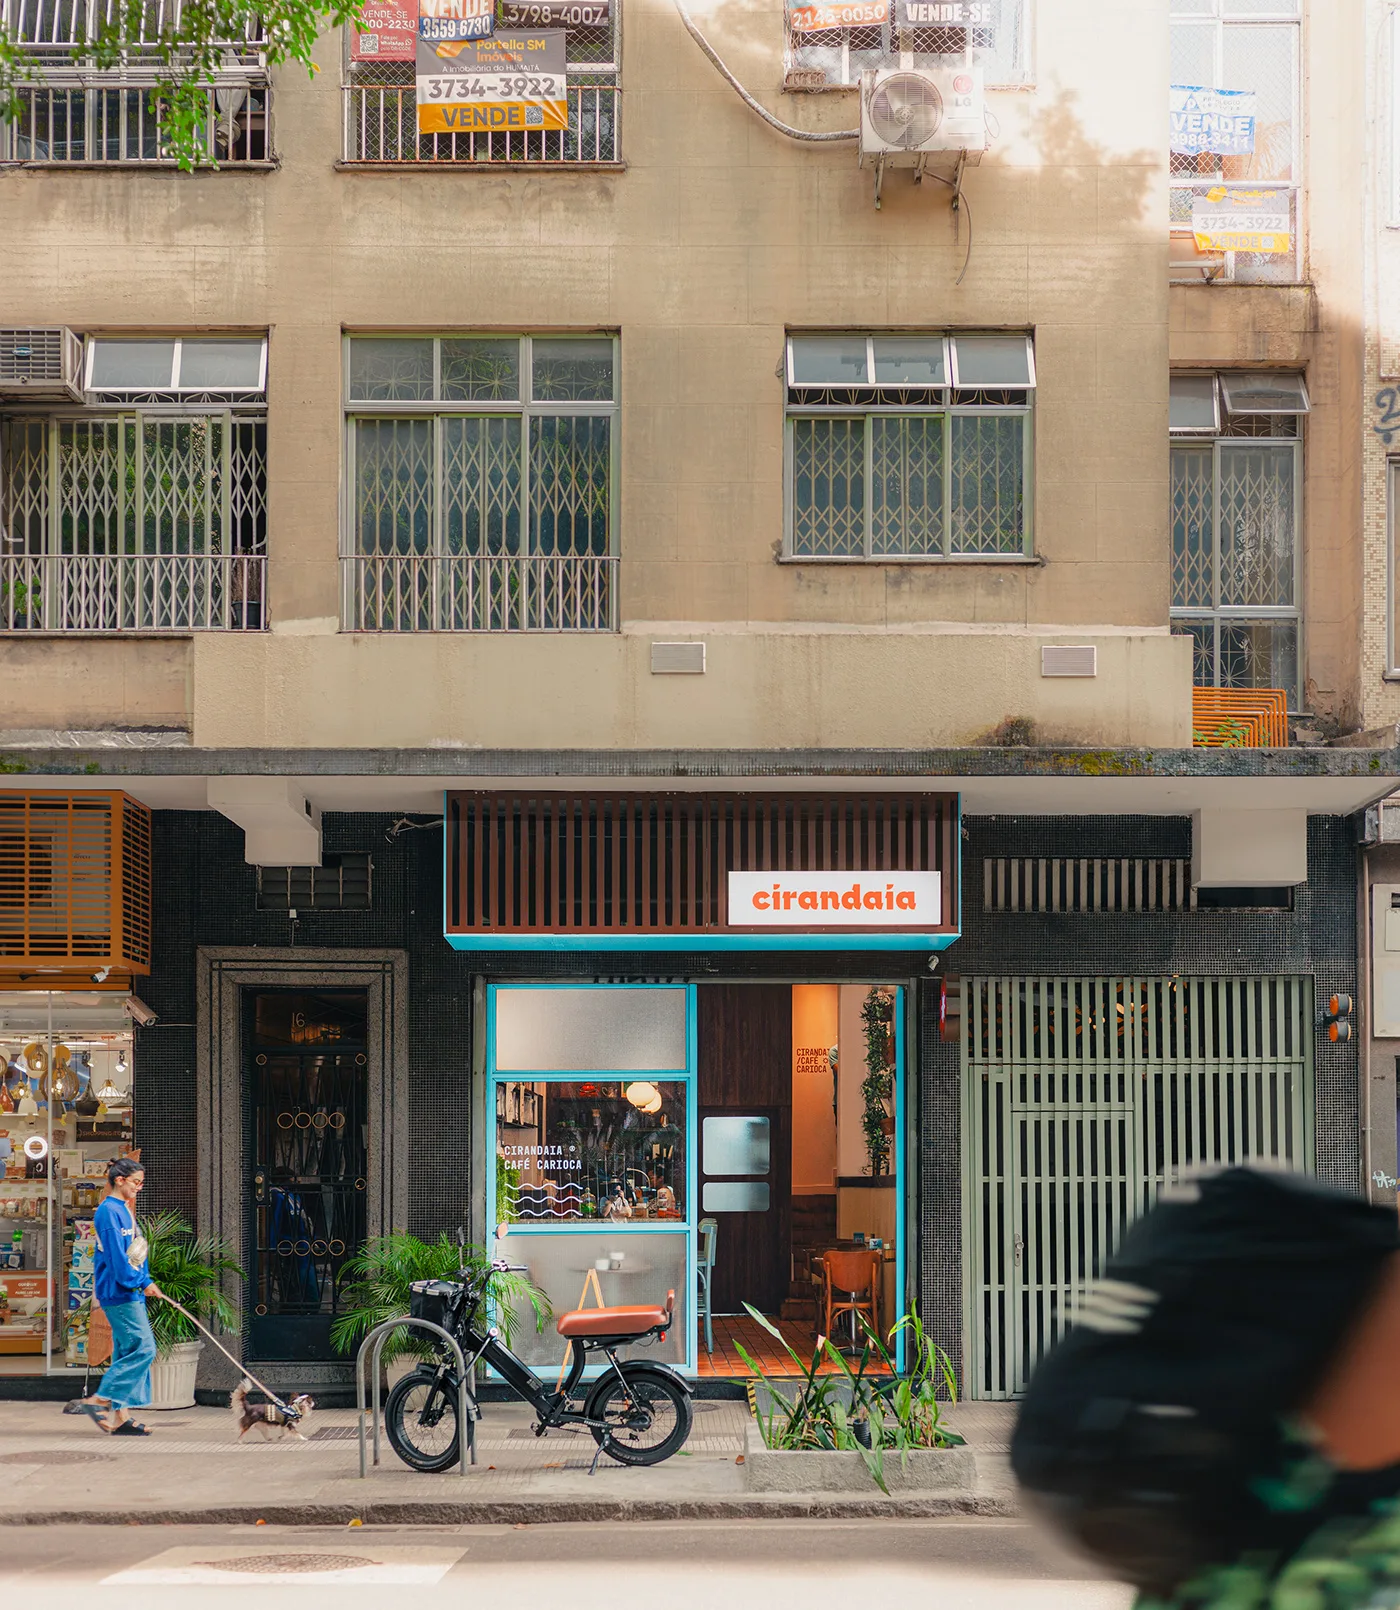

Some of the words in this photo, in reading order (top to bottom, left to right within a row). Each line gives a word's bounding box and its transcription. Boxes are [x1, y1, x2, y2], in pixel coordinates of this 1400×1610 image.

[362, 10, 408, 19] VENDE-SE
[508, 5, 604, 24] 3798-4007
[907, 3, 991, 22] VENDE-SE
[423, 15, 490, 39] 3559-6730
[476, 39, 525, 51] Portella
[527, 39, 546, 51] SM
[476, 50, 523, 62] Imóveis
[428, 78, 556, 99] 3734-3922
[955, 96, 972, 107] LG
[442, 106, 521, 127] VENDE
[1170, 112, 1250, 136] VENDE
[1200, 216, 1283, 231] 3734-3922
[1209, 235, 1259, 249] VENDE
[752, 883, 916, 911] cirandaia
[292, 1012, 305, 1028] 16
[796, 1065, 827, 1073] CARIOCA
[504, 1145, 563, 1156] CIRANDAIA
[504, 1158, 530, 1170] CAFÉ
[537, 1161, 582, 1171] CARIOCA
